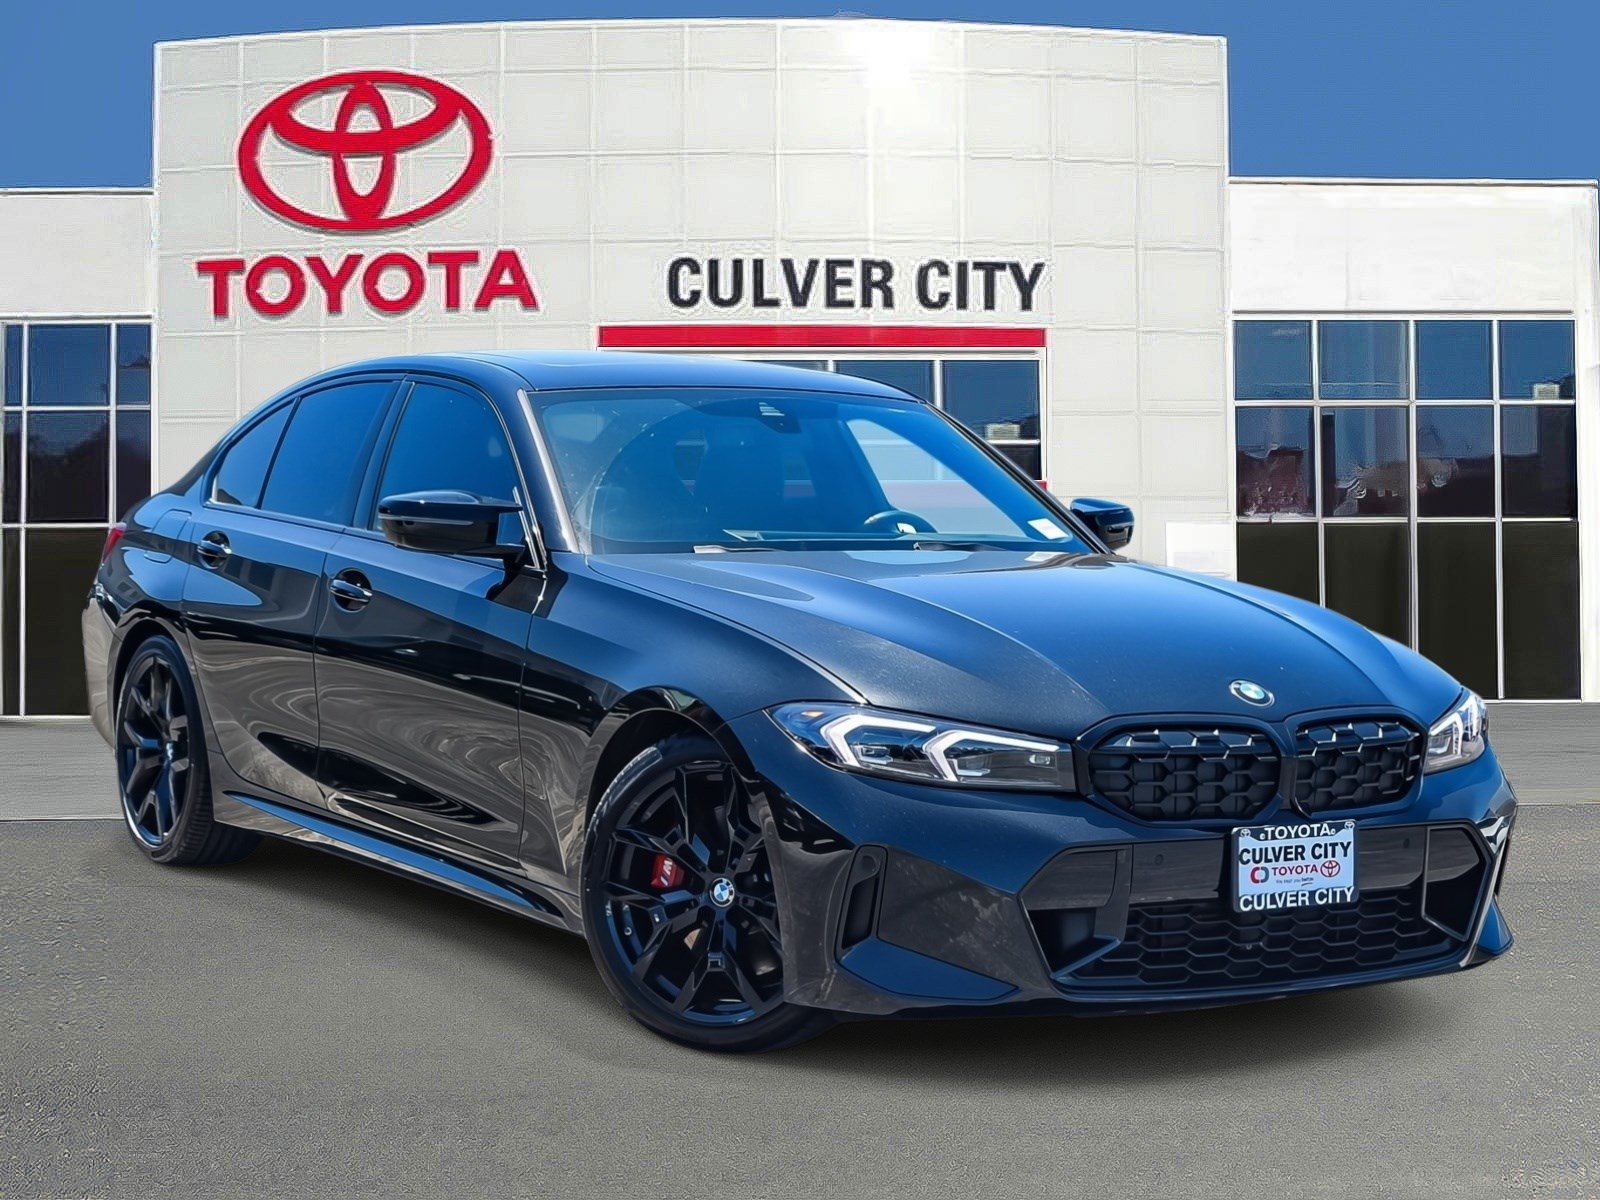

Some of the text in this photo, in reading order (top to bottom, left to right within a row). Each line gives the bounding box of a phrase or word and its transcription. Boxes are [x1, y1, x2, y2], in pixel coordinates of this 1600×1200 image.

[196, 250, 539, 318] TOYOTA
[667, 257, 1046, 311] CULVER CITY
[1264, 823, 1331, 840] TOYOTA
[1239, 841, 1352, 865] CULVER CITY
[1271, 864, 1319, 876] TOYOTA
[1240, 886, 1354, 912] CULVER CITY
